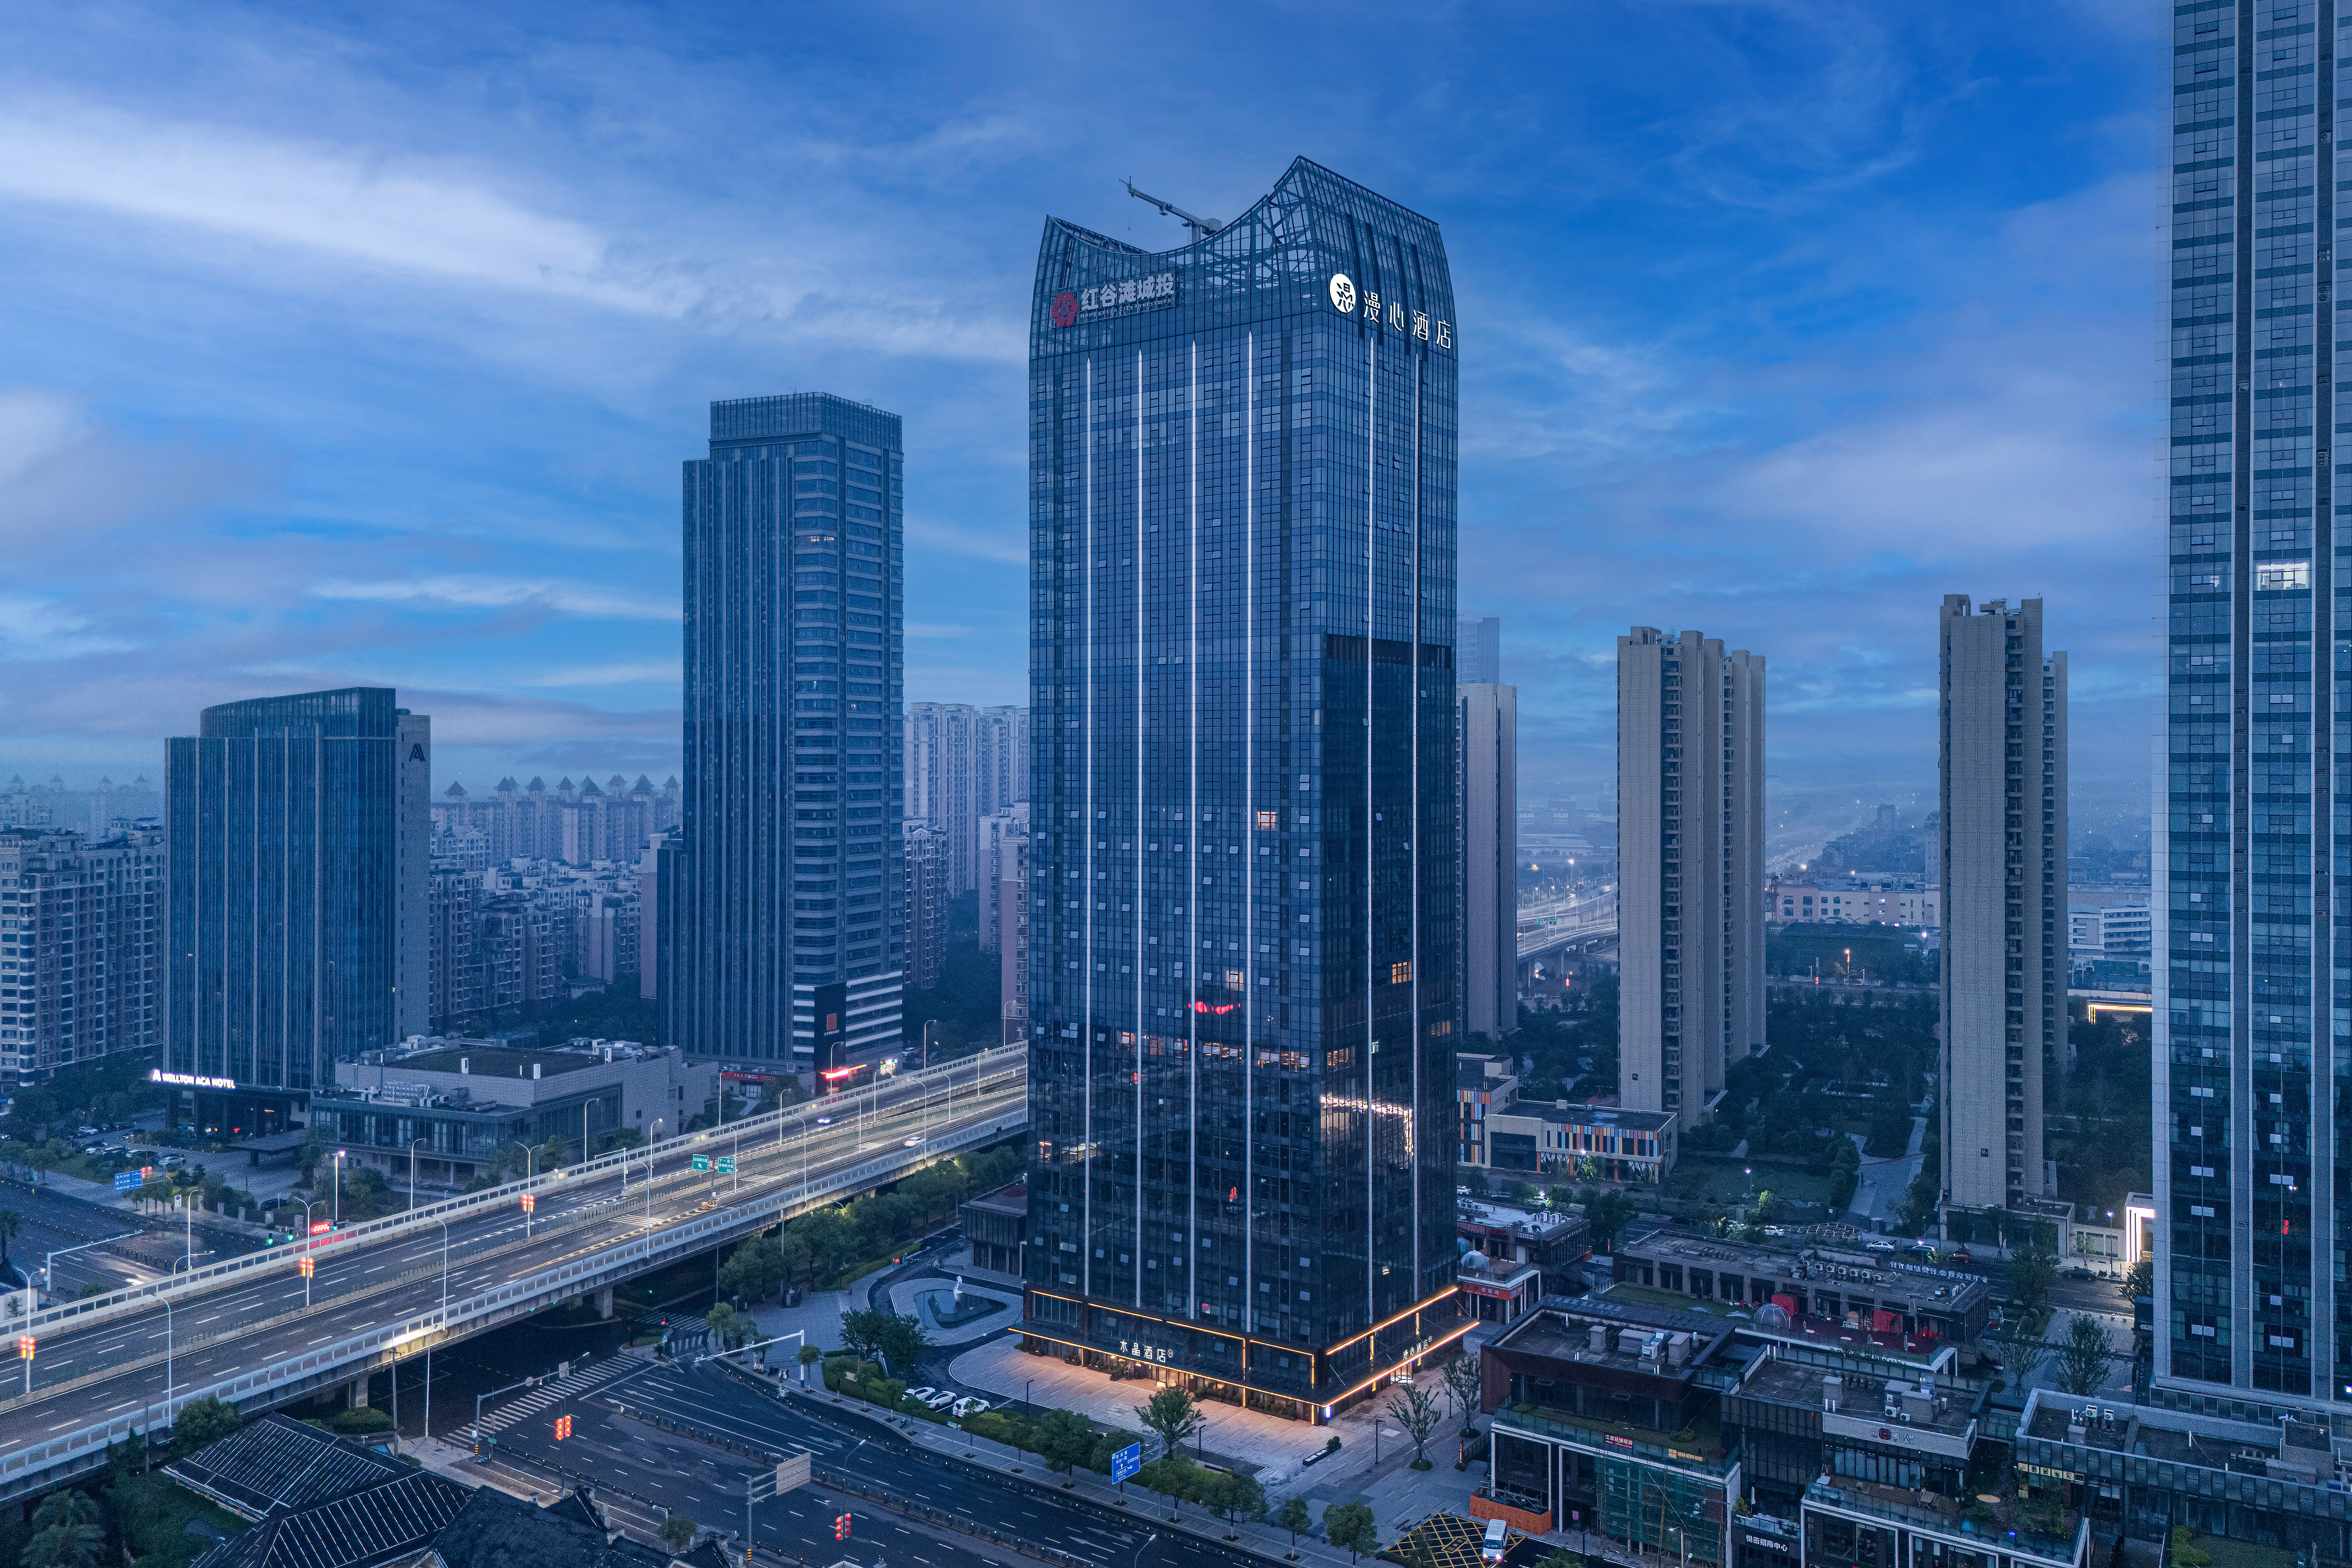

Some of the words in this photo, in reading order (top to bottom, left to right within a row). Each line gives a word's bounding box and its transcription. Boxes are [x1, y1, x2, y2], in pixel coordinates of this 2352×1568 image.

[1081, 273, 1175, 311] 红谷滩城投
[1363, 290, 1451, 349] 漫心酒店
[211, 1078, 236, 1089] HOTEL
[1120, 1340, 1166, 1363] 水晶酒店
[1403, 1339, 1428, 1361] 漫心酒店
[1746, 1535, 1788, 1551] 悦街招商中心
